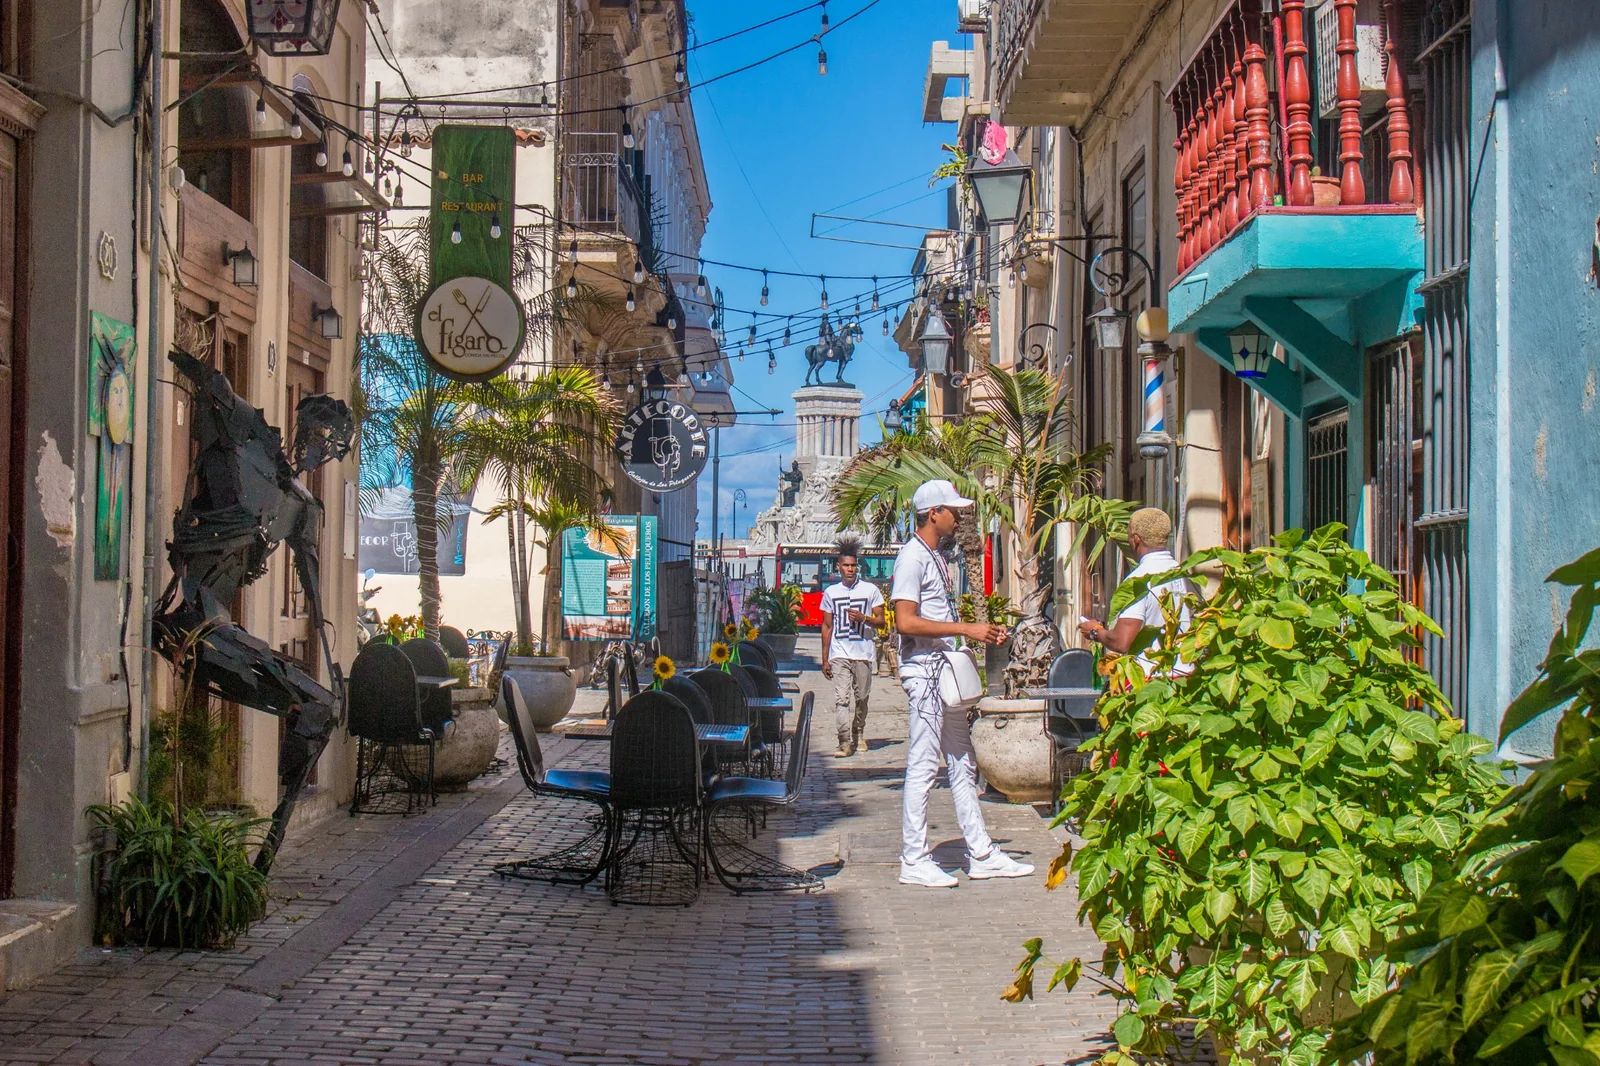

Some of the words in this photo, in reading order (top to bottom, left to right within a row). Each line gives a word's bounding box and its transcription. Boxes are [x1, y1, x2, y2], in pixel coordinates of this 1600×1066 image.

[462, 173, 484, 183] BAR
[441, 201, 504, 212] RESTAURANT
[428, 303, 443, 322] el
[619, 400, 706, 460] ARTECORTE
[644, 521, 652, 570] PELUQUEROS
[644, 586, 651, 597] DE
